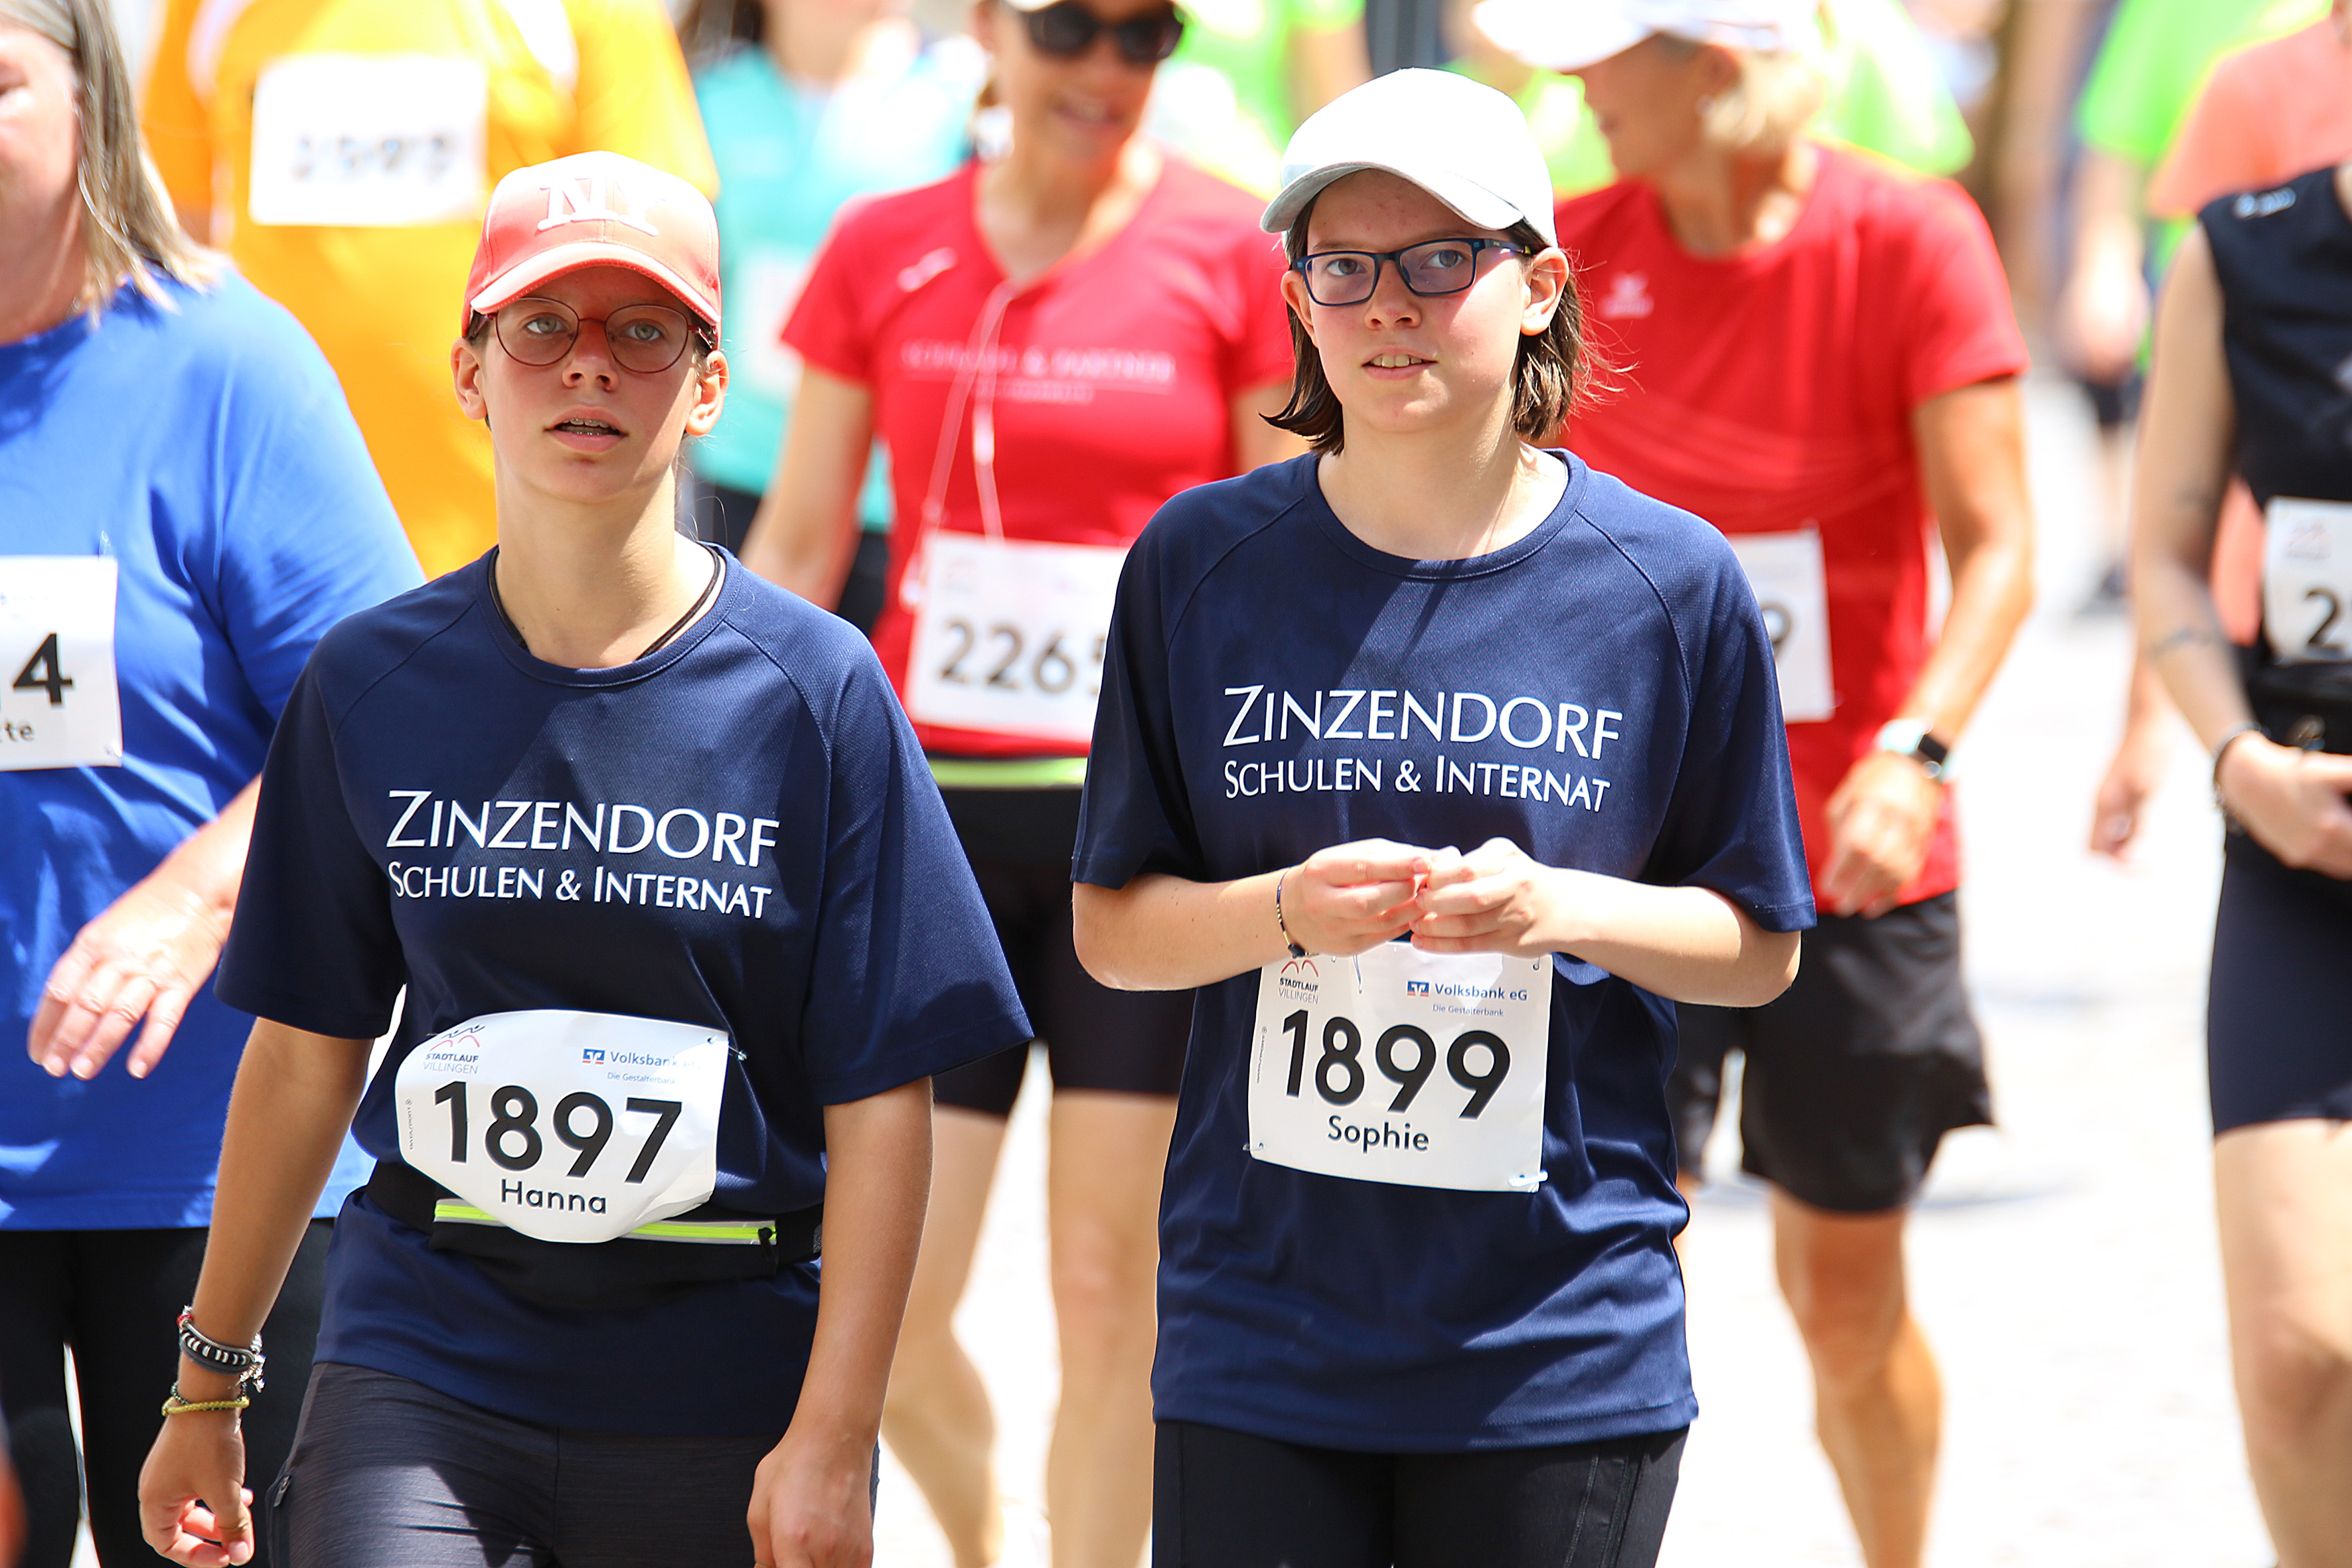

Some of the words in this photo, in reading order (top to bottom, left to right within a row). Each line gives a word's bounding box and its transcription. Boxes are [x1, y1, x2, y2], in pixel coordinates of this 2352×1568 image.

[536, 175, 666, 237] NY
[2306, 588, 2352, 649] 2
[1223, 684, 1624, 761] ZINZENDORF
[1223, 758, 1382, 799] SCHULEN
[1395, 759, 1422, 793] &
[1436, 755, 1611, 813] INTERNAT
[386, 790, 781, 868] ZINZENDORF
[388, 861, 546, 900] SCHULEN
[556, 869, 583, 902] &
[594, 866, 773, 919] INTERNAT
[1279, 977, 1319, 992] STADTLAUF
[1279, 988, 1319, 1004] VILLINGEN
[1435, 983, 1505, 1000] Volksbank
[1510, 989, 1528, 1001] eG
[1448, 1005, 1504, 1017] Gestalterbank
[423, 1061, 479, 1074] VILLINGEN
[425, 1053, 479, 1063] STADTLAUF
[610, 1051, 678, 1067] Volksbank
[1283, 1009, 1510, 1120] 1899
[607, 1071, 620, 1081] Die
[622, 1073, 676, 1085] Gestalterbank
[435, 1081, 682, 1184] 1897
[1328, 1115, 1429, 1153] Sophie
[502, 1179, 607, 1214] Hanna
